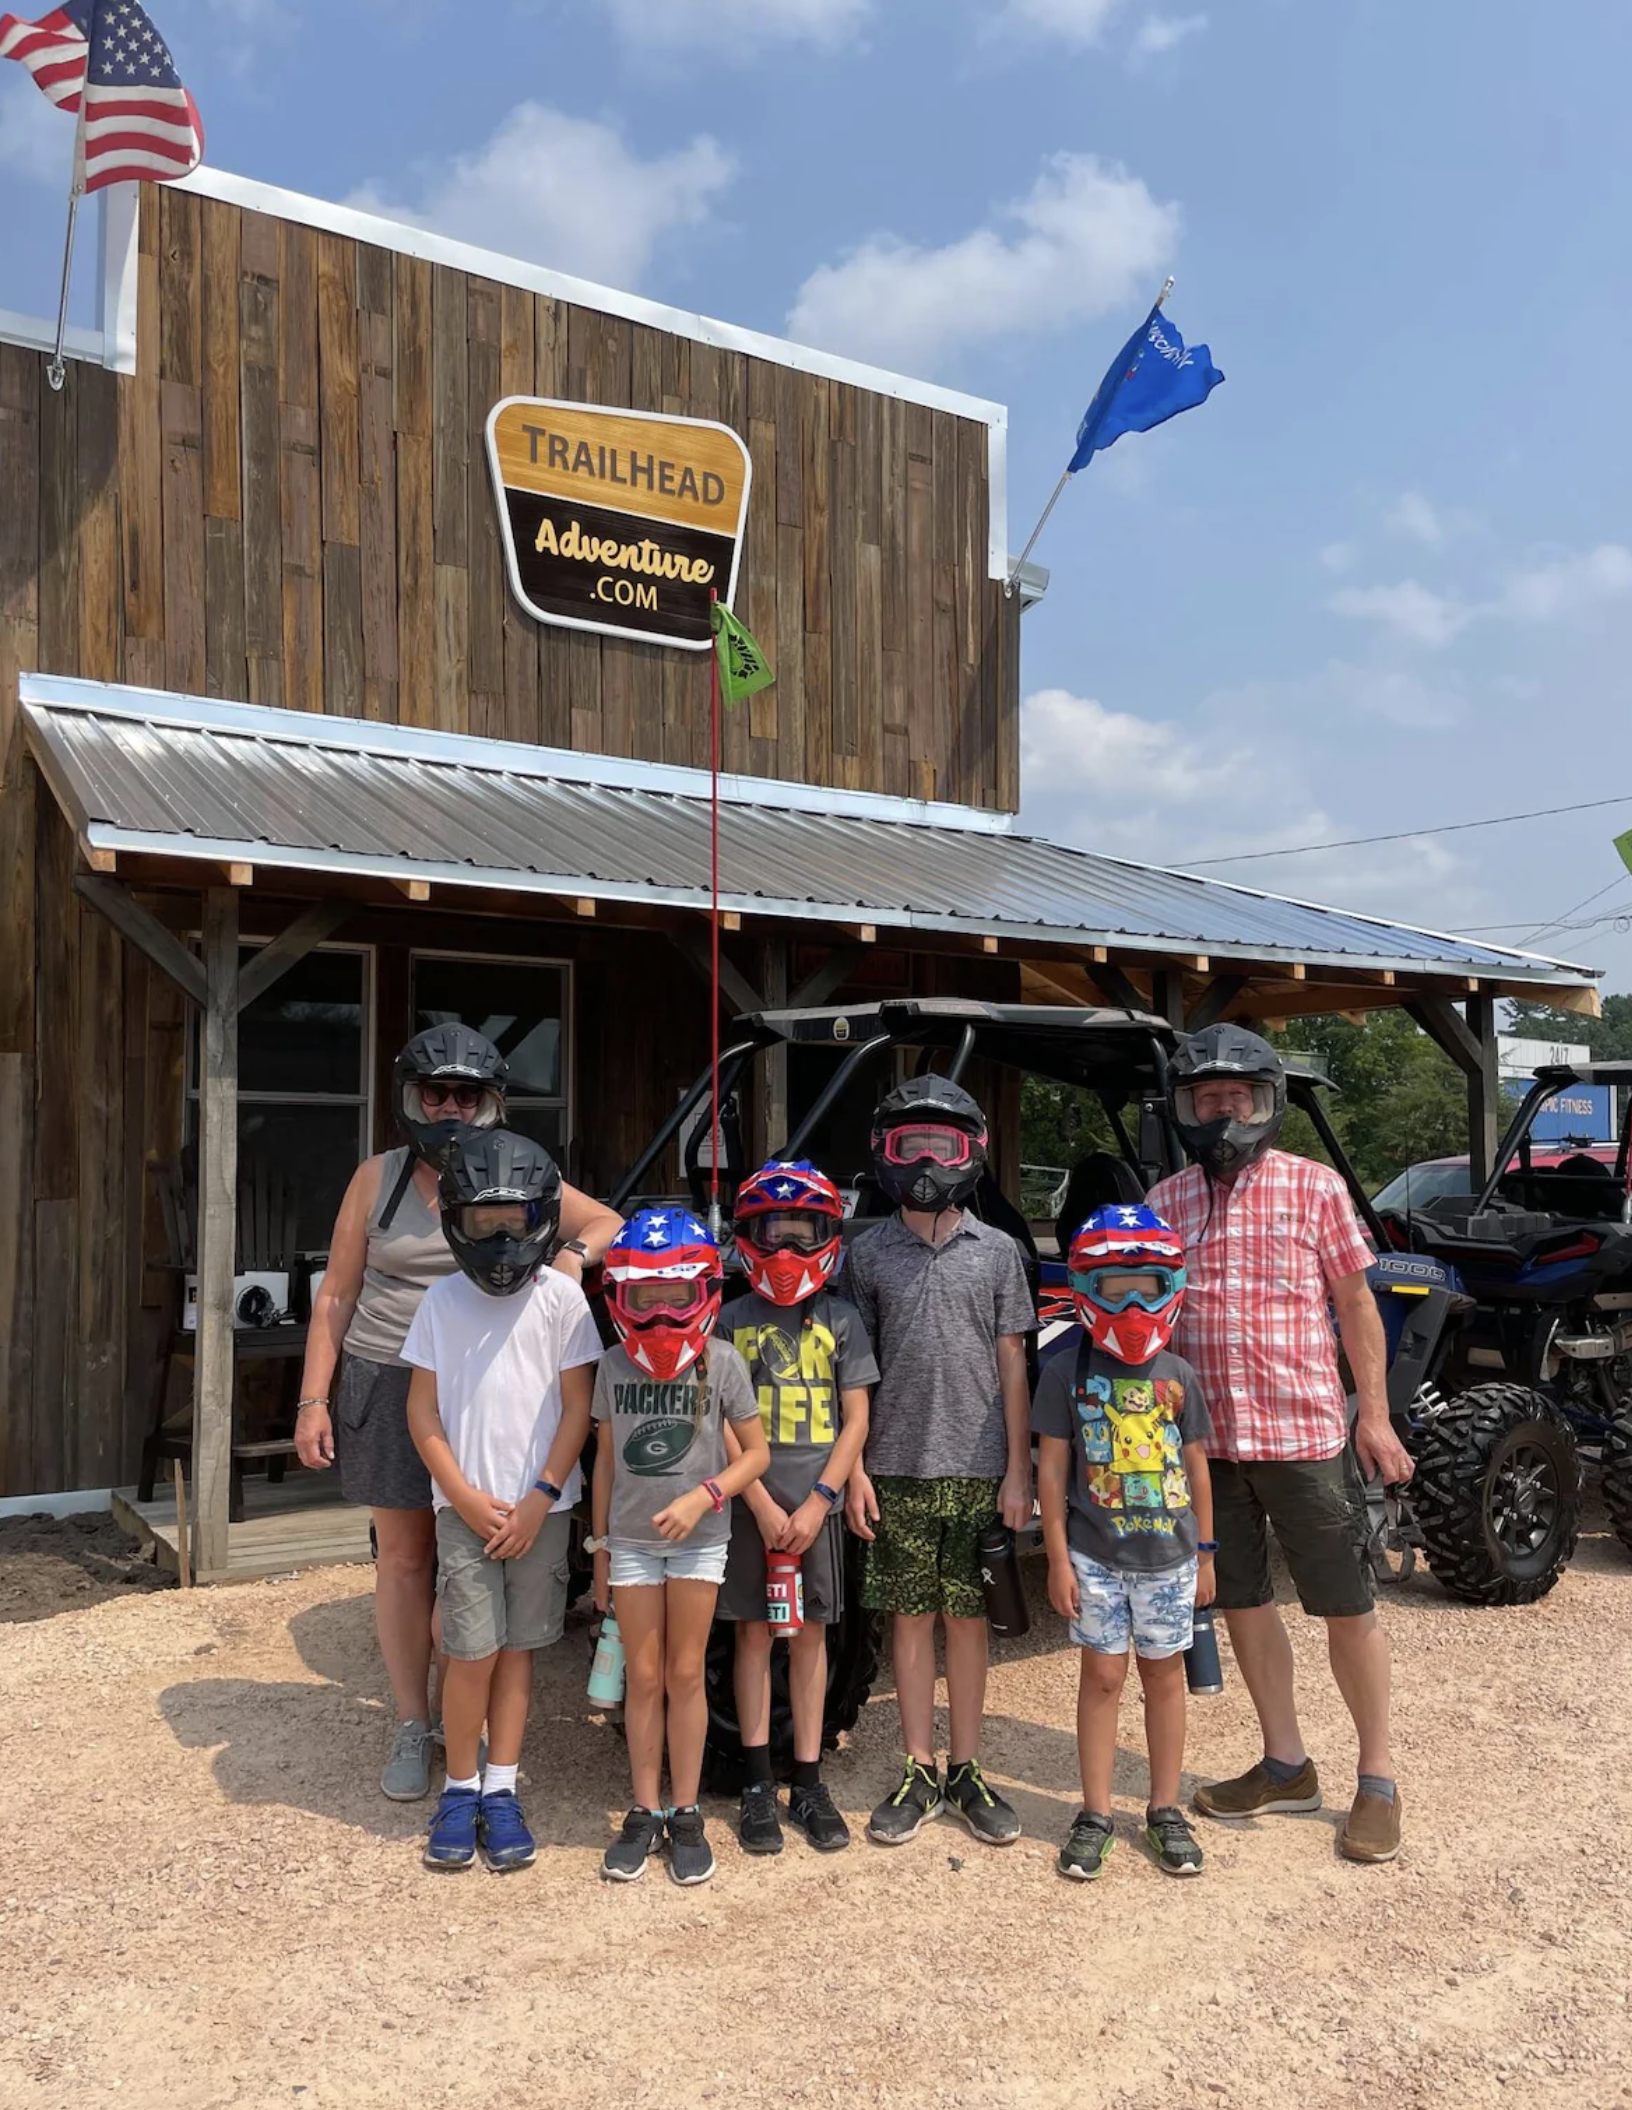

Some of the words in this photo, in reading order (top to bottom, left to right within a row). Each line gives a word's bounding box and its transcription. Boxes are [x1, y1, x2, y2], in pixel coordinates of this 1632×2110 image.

[521, 423, 726, 506] TRAILHEAD
[534, 517, 715, 585] Adventure
[589, 576, 659, 611] .COM
[1560, 1098, 1593, 1115] FITNESS
[1379, 1258, 1446, 1282] 1000
[613, 1383, 712, 1417] PACKERS
[757, 1385, 835, 1444] IFE
[766, 1583, 788, 1598] ETI
[767, 1605, 787, 1620] ETI
